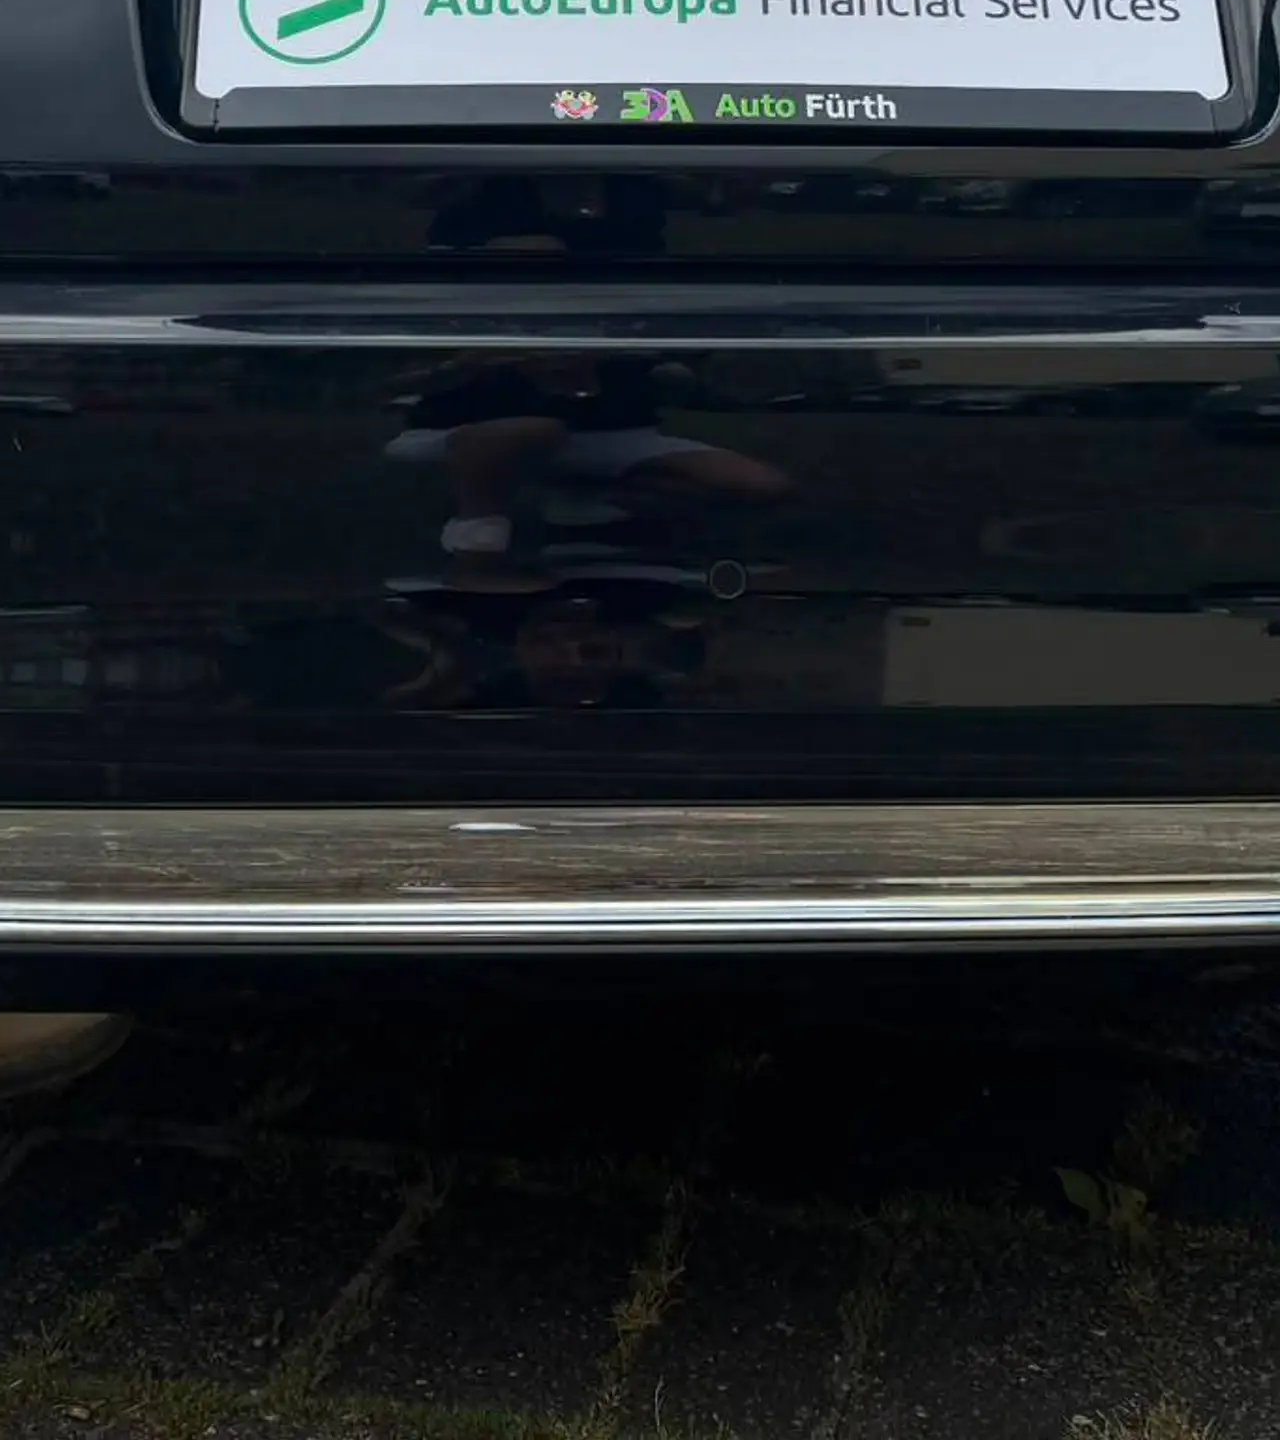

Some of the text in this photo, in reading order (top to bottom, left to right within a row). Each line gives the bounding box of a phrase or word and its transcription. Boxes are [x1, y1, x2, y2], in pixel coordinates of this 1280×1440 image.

[620, 87, 897, 123] 3DA Auto Fürth
